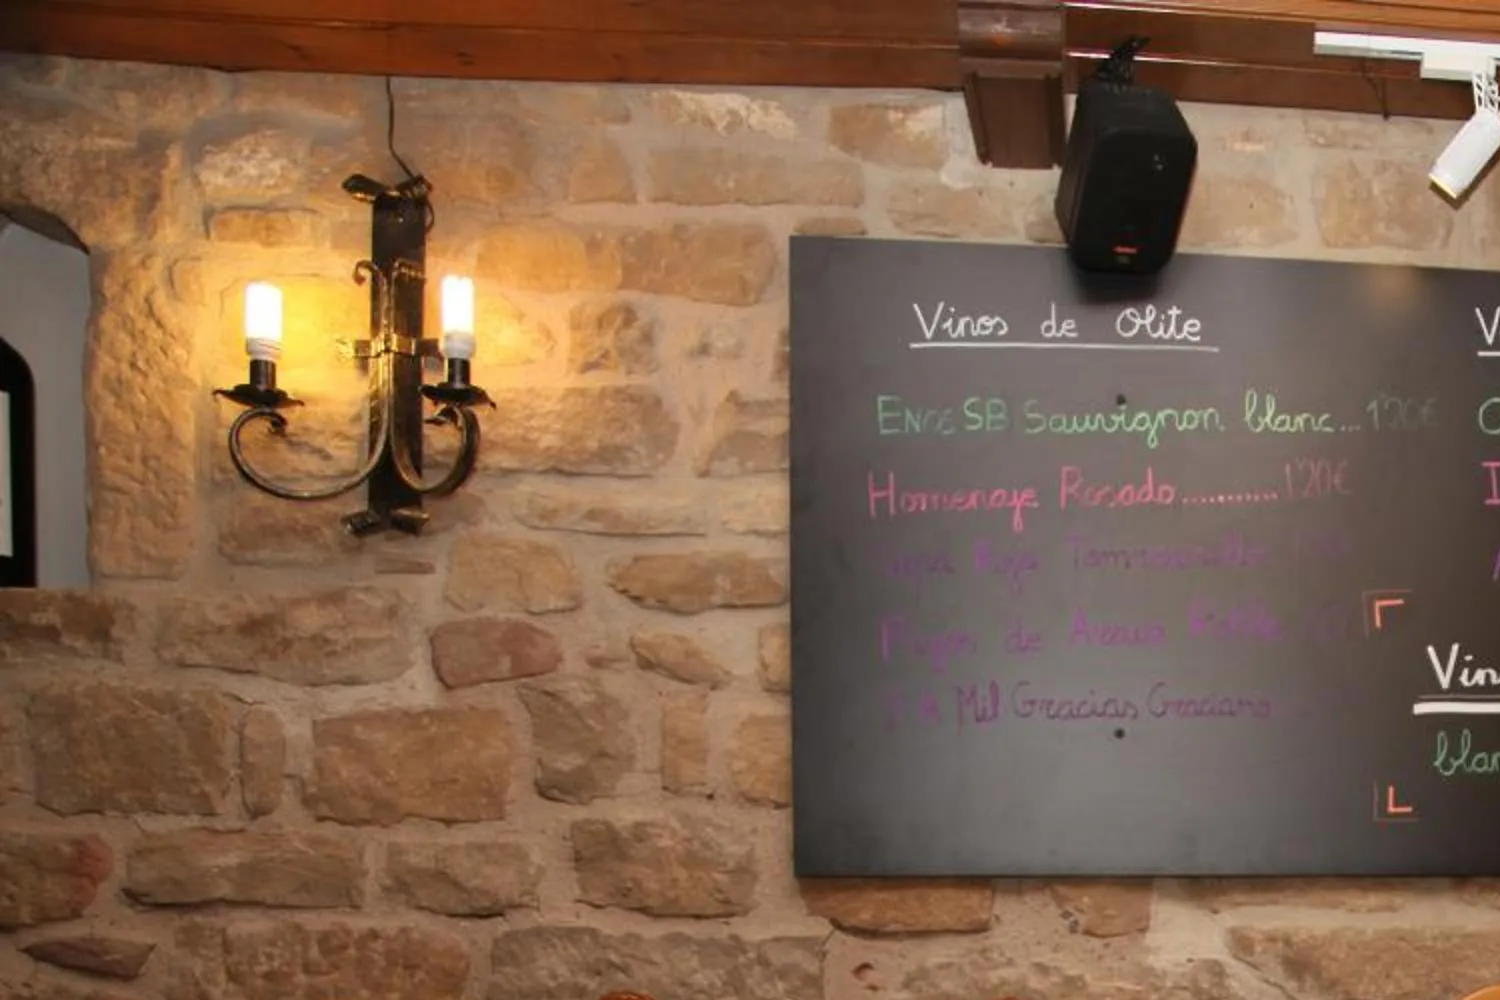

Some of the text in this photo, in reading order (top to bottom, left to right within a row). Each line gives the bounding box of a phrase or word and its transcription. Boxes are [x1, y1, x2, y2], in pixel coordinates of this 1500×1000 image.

[913, 301, 1201, 341] Vinos de Olite
[1024, 399, 1225, 448] Sauvignon
